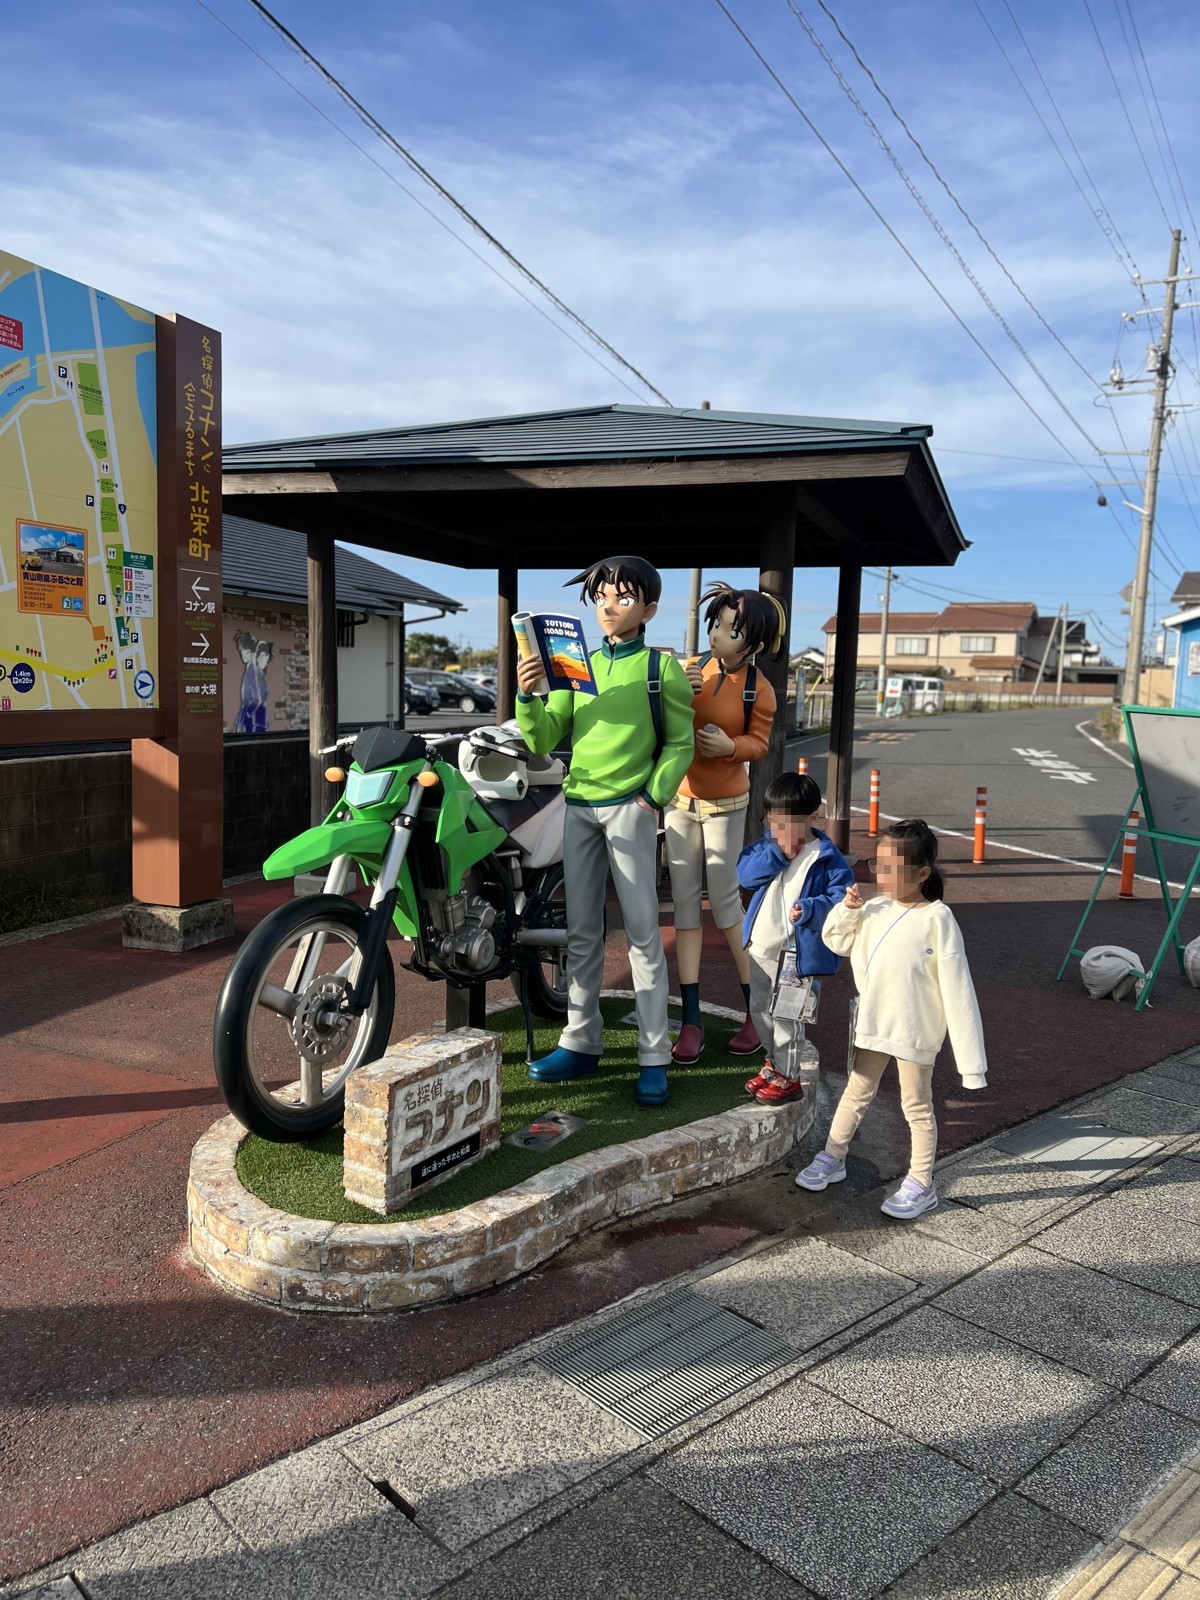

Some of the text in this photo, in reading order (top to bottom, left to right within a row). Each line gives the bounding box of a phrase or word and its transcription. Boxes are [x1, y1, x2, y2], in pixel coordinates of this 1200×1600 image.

[199, 335, 216, 474] 名探偵コナンに
[183, 382, 197, 477] 会えるまち
[188, 482, 212, 562] 北栄町
[185, 600, 216, 615] コナン駅
[544, 628, 564, 636] ROAD
[545, 620, 574, 629] TOTTORI
[14, 670, 31, 678] 1.4km
[201, 683, 217, 696] 大栄
[403, 1078, 444, 1112] 名探偵
[400, 1078, 491, 1161] コナン
